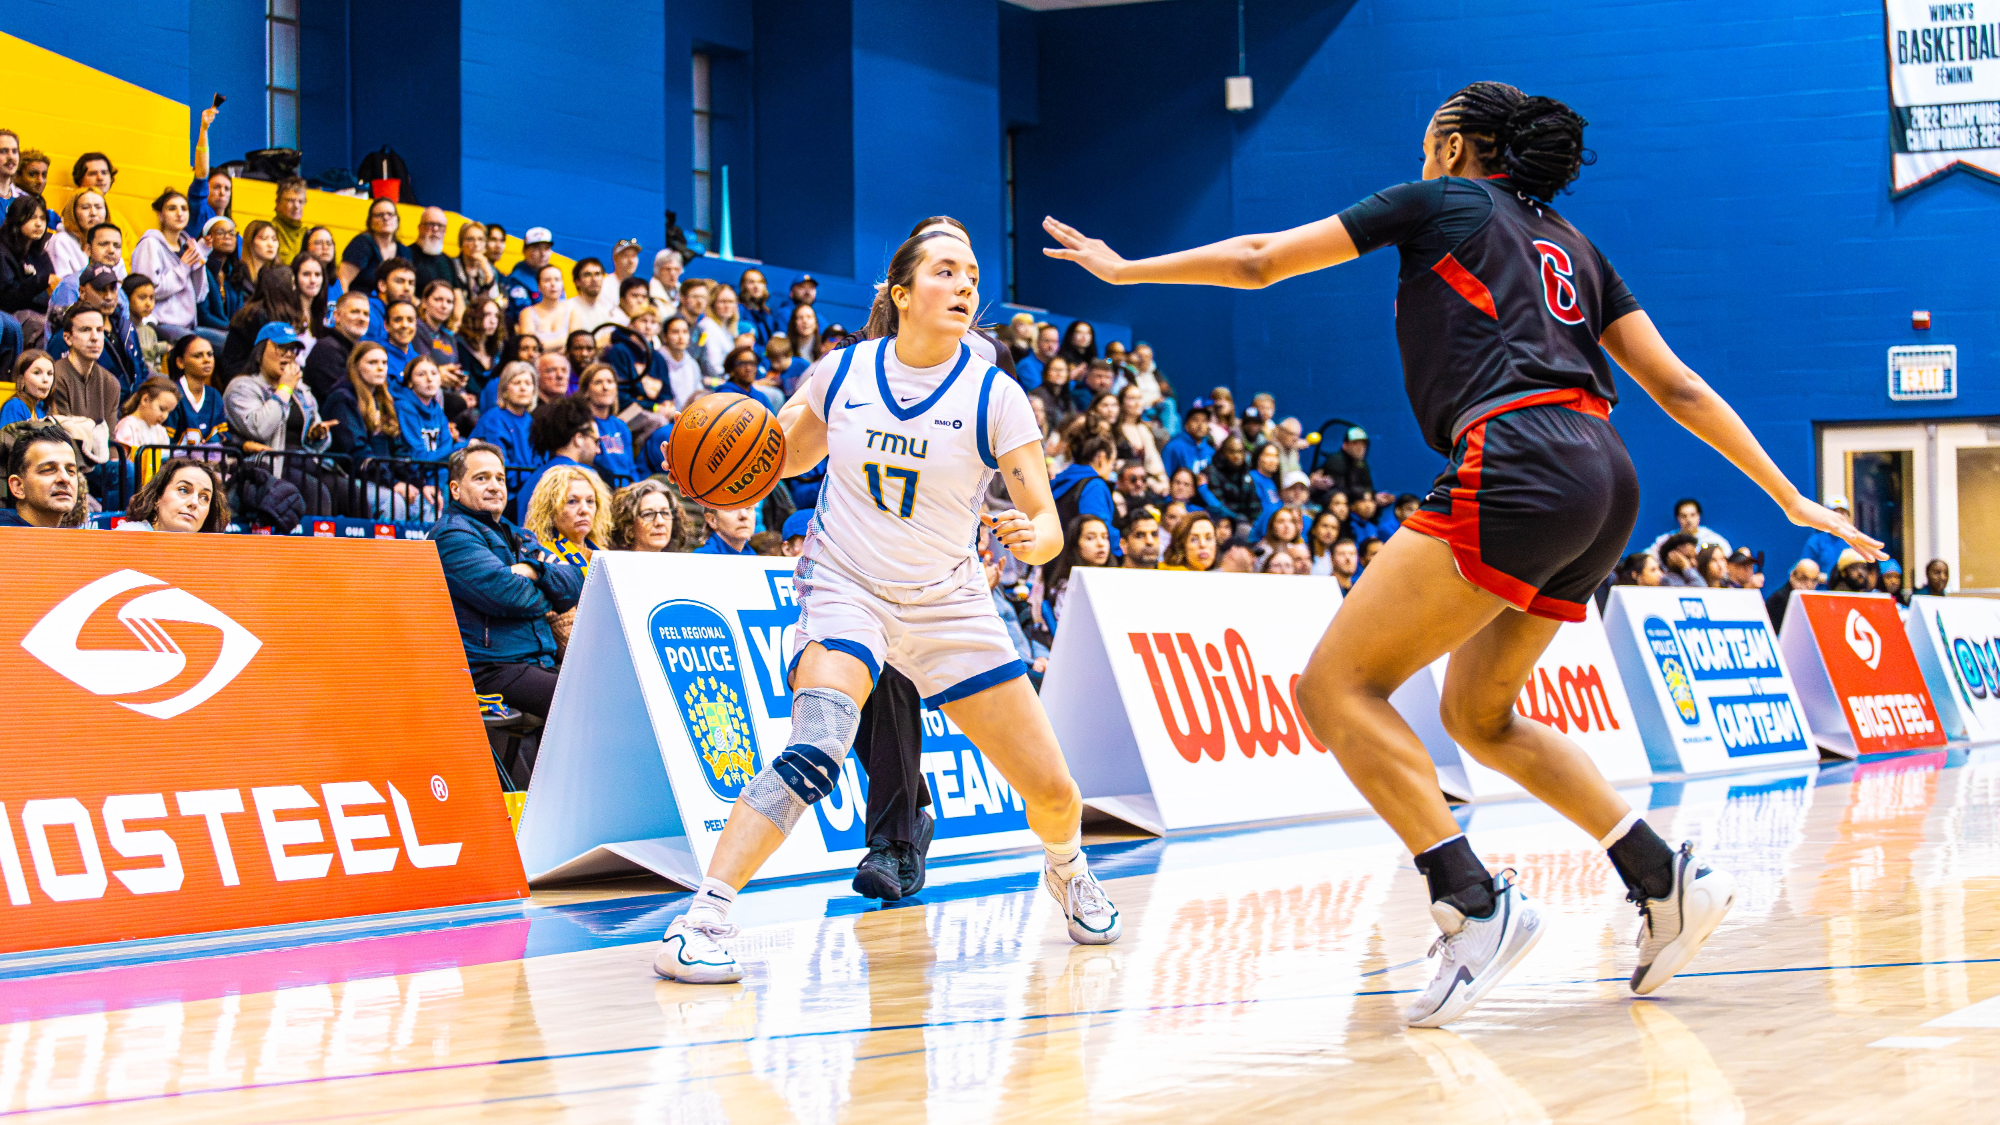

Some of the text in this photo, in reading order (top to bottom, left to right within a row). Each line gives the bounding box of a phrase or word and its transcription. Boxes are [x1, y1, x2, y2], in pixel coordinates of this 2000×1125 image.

[1928, 3, 1974, 21] WOMEN'S
[1897, 24, 2000, 65] BASKETBAL
[1533, 240, 1585, 325] 6
[1906, 366, 1938, 391] EXIT
[934, 419, 951, 427] BMO
[707, 411, 754, 474] EVOLUTION
[866, 429, 928, 459] TMU
[725, 428, 782, 495] Wilson
[862, 461, 920, 519] 17
[659, 626, 725, 640] PEEL REGIONAL
[665, 646, 735, 673] POLICE
